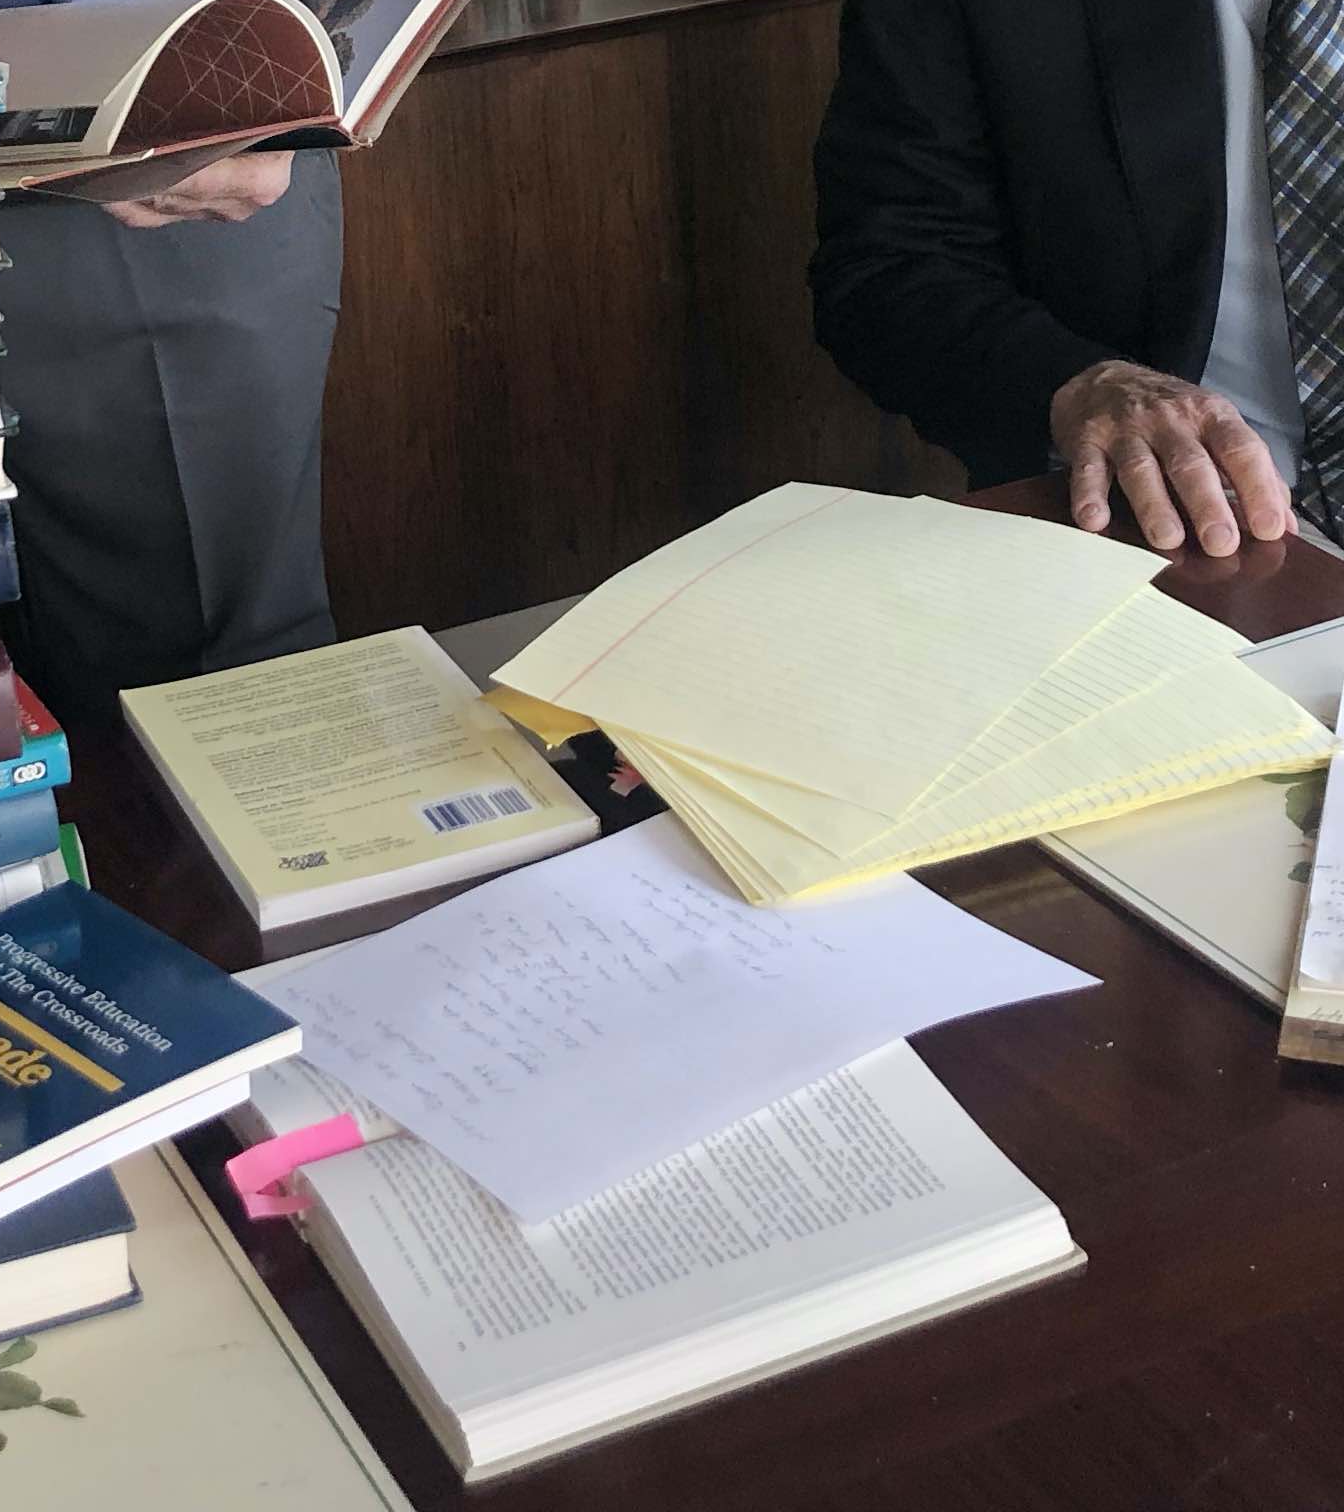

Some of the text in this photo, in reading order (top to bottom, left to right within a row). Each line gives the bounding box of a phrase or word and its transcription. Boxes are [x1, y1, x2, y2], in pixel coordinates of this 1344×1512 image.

[0, 967, 35, 994] The
[32, 989, 129, 1055] Crossroads
[81, 990, 174, 1053] Education
